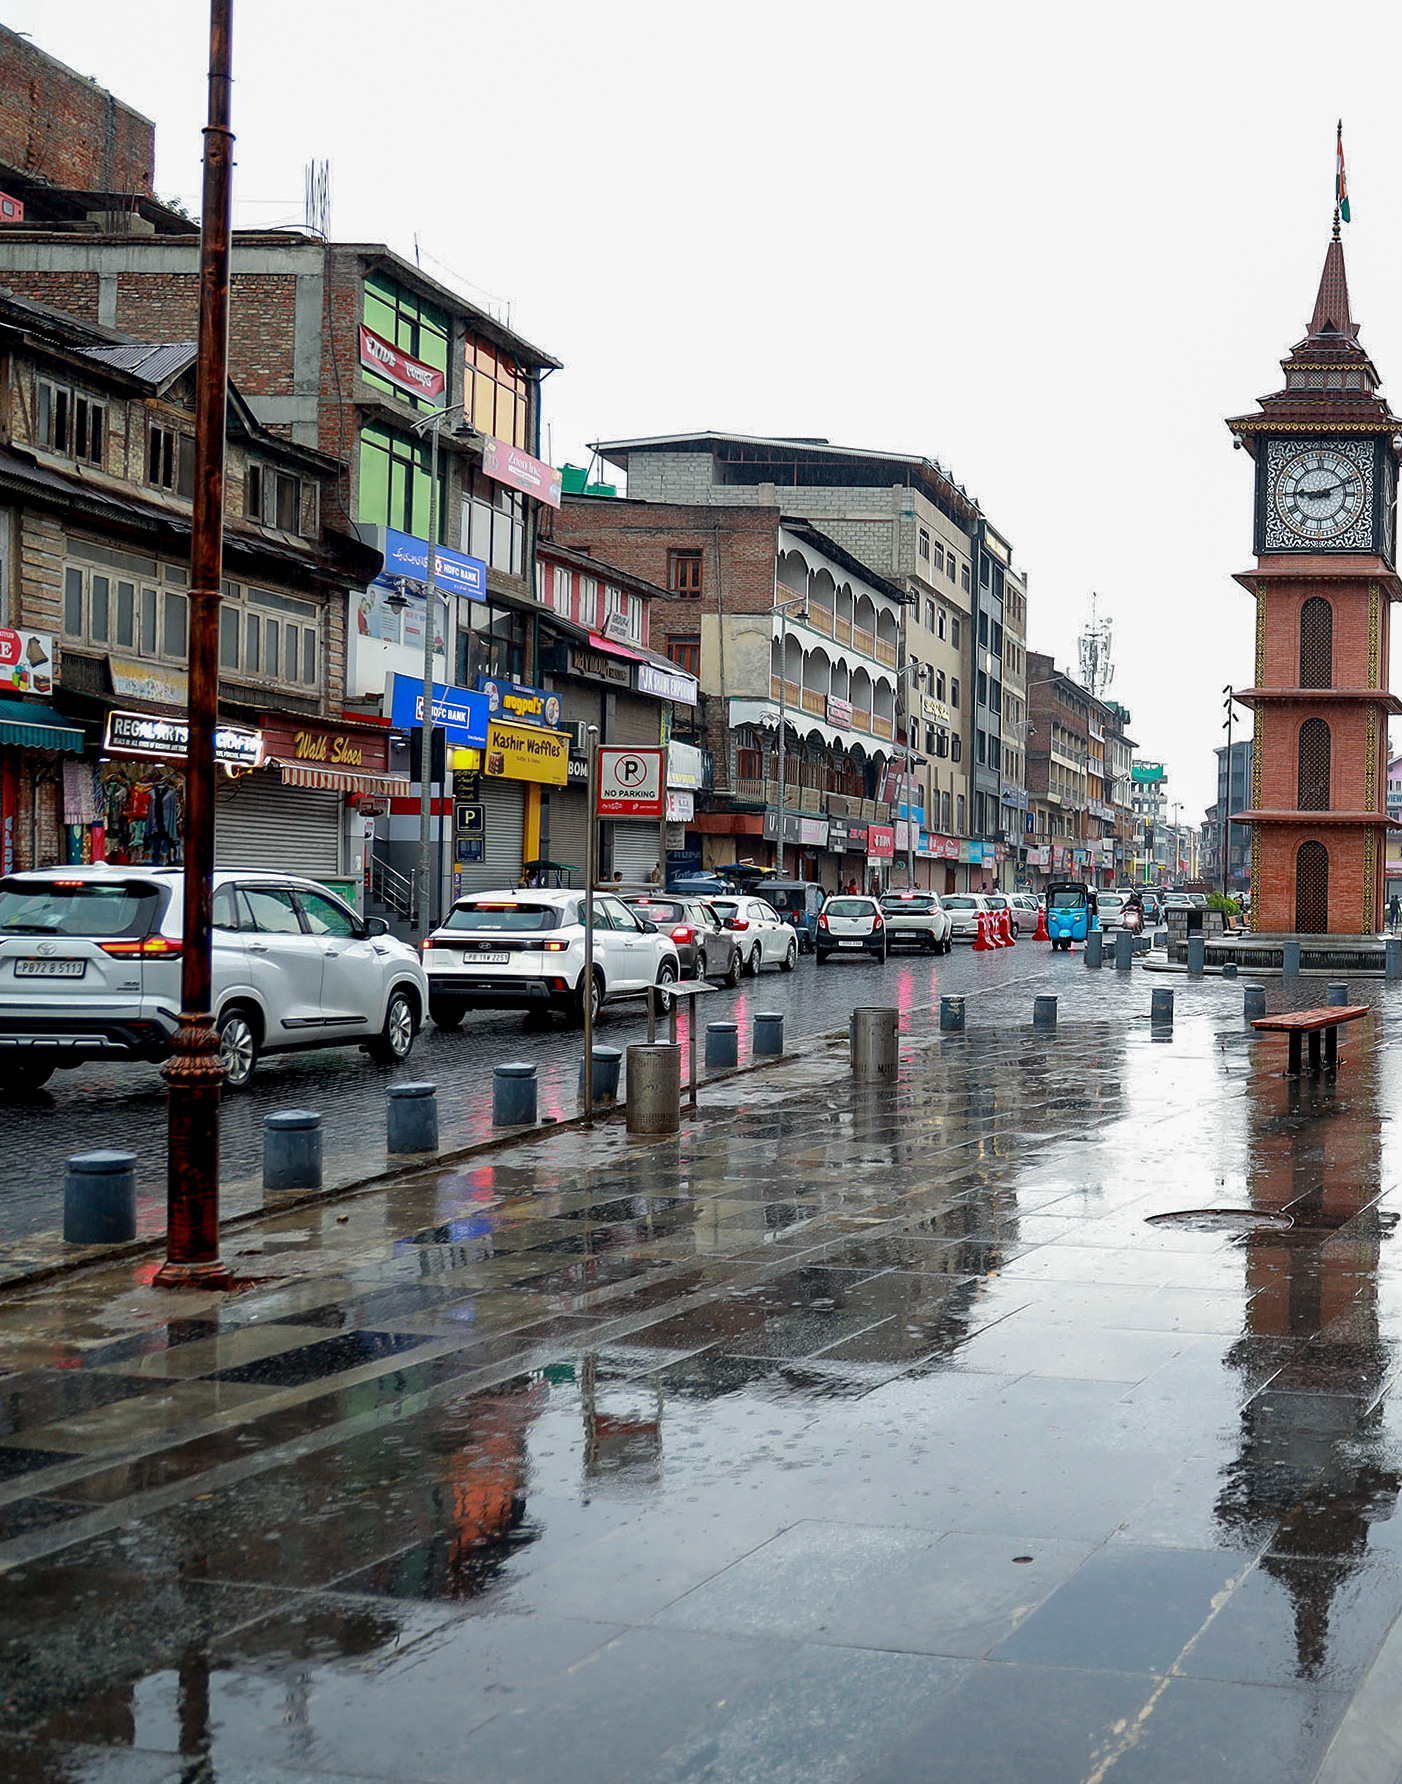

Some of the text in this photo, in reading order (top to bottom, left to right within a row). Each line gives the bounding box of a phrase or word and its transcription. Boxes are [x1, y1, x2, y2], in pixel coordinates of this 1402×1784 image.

[444, 563, 477, 582] HDFC BANK
[447, 709, 467, 723] BANK
[114, 718, 155, 739] REGAL
[294, 731, 362, 766] Walk Shoes
[493, 731, 525, 750] Kashir
[527, 738, 561, 758] Waffles
[568, 762, 588, 777] BOM
[625, 761, 638, 781] P
[618, 790, 655, 798] PARKING
[465, 810, 476, 824] P
[22, 962, 46, 973] PB72
